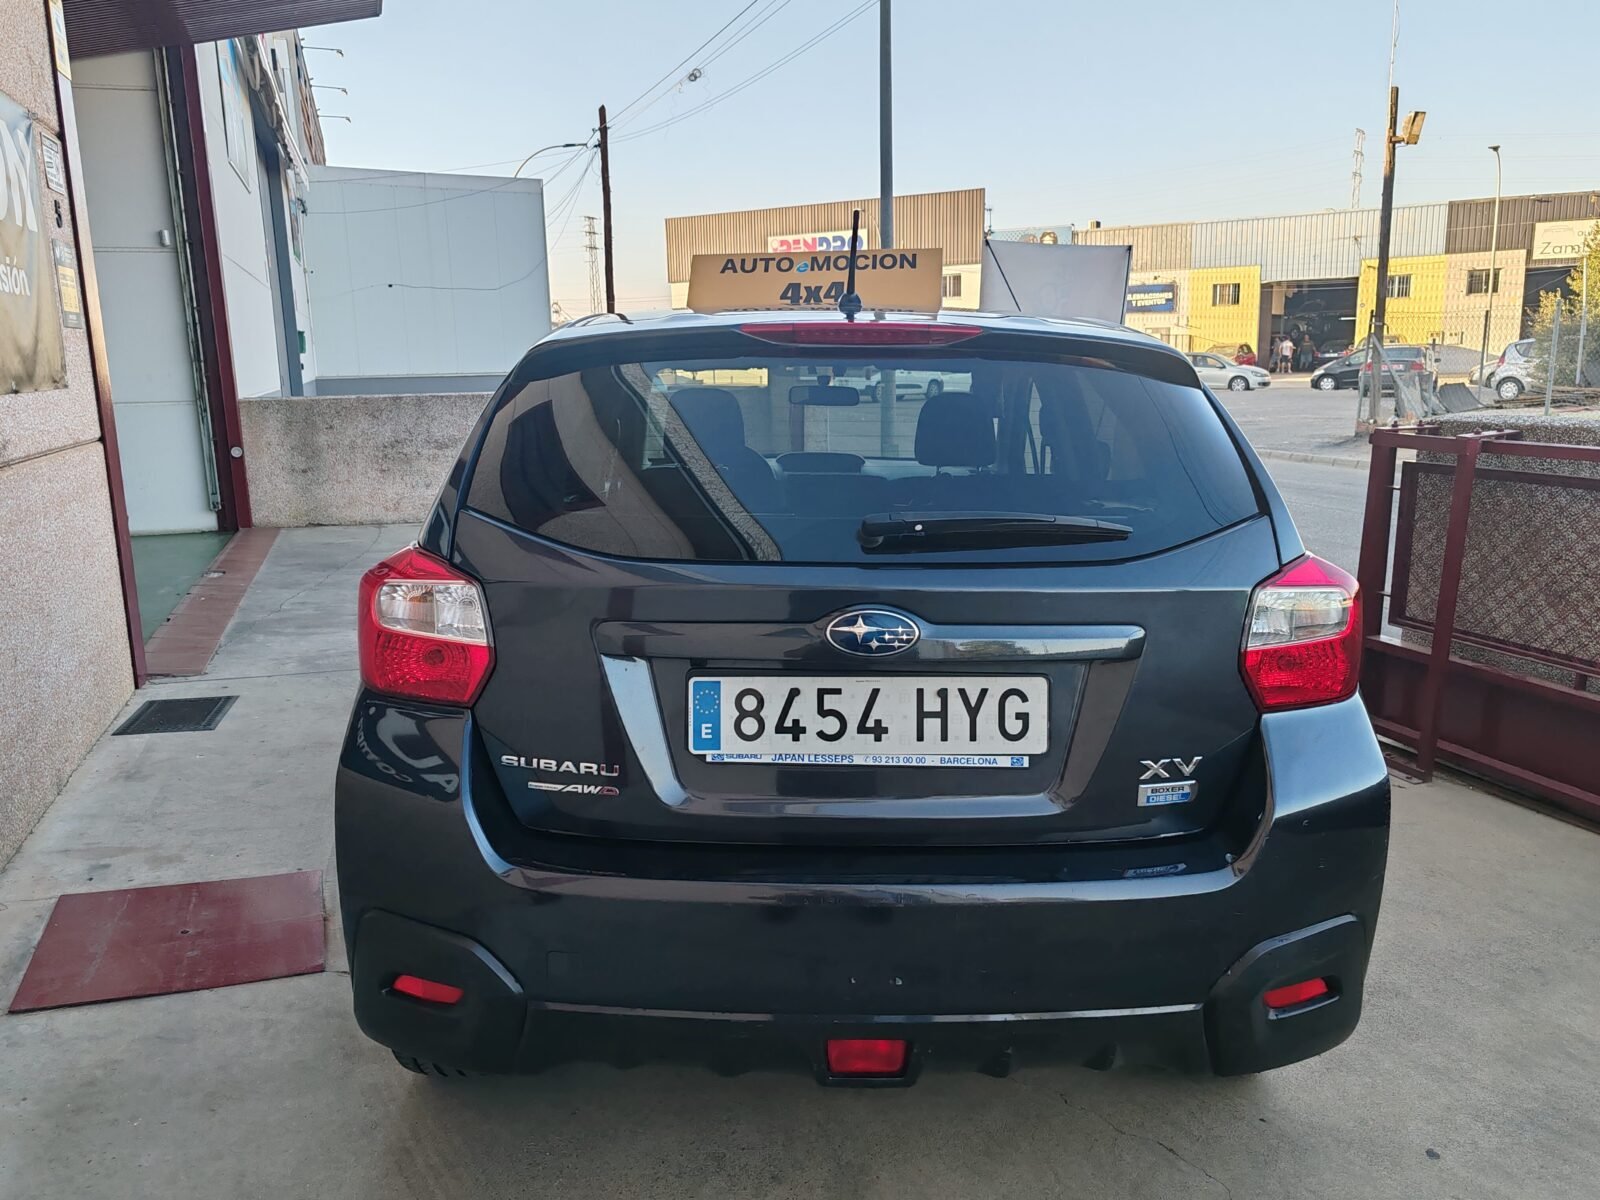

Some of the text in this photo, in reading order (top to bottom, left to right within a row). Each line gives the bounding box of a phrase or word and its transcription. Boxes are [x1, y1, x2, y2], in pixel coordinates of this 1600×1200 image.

[0, 255, 31, 297] sión
[780, 281, 845, 305] 4x4
[733, 688, 1030, 742] 8454 HYG
[702, 723, 713, 738] E
[501, 755, 620, 777] SUBARU
[771, 754, 805, 763] JAPAN
[808, 754, 854, 764] LESSEPS
[872, 756, 882, 764] 93
[885, 756, 900, 764] 213
[903, 756, 913, 764] 00
[915, 756, 927, 764] 00
[940, 756, 998, 766] BARCELONA
[1139, 756, 1203, 780] XV
[561, 784, 620, 796] AWD
[1149, 793, 1187, 803] DIESEL
[1151, 786, 1185, 794] BOXER
